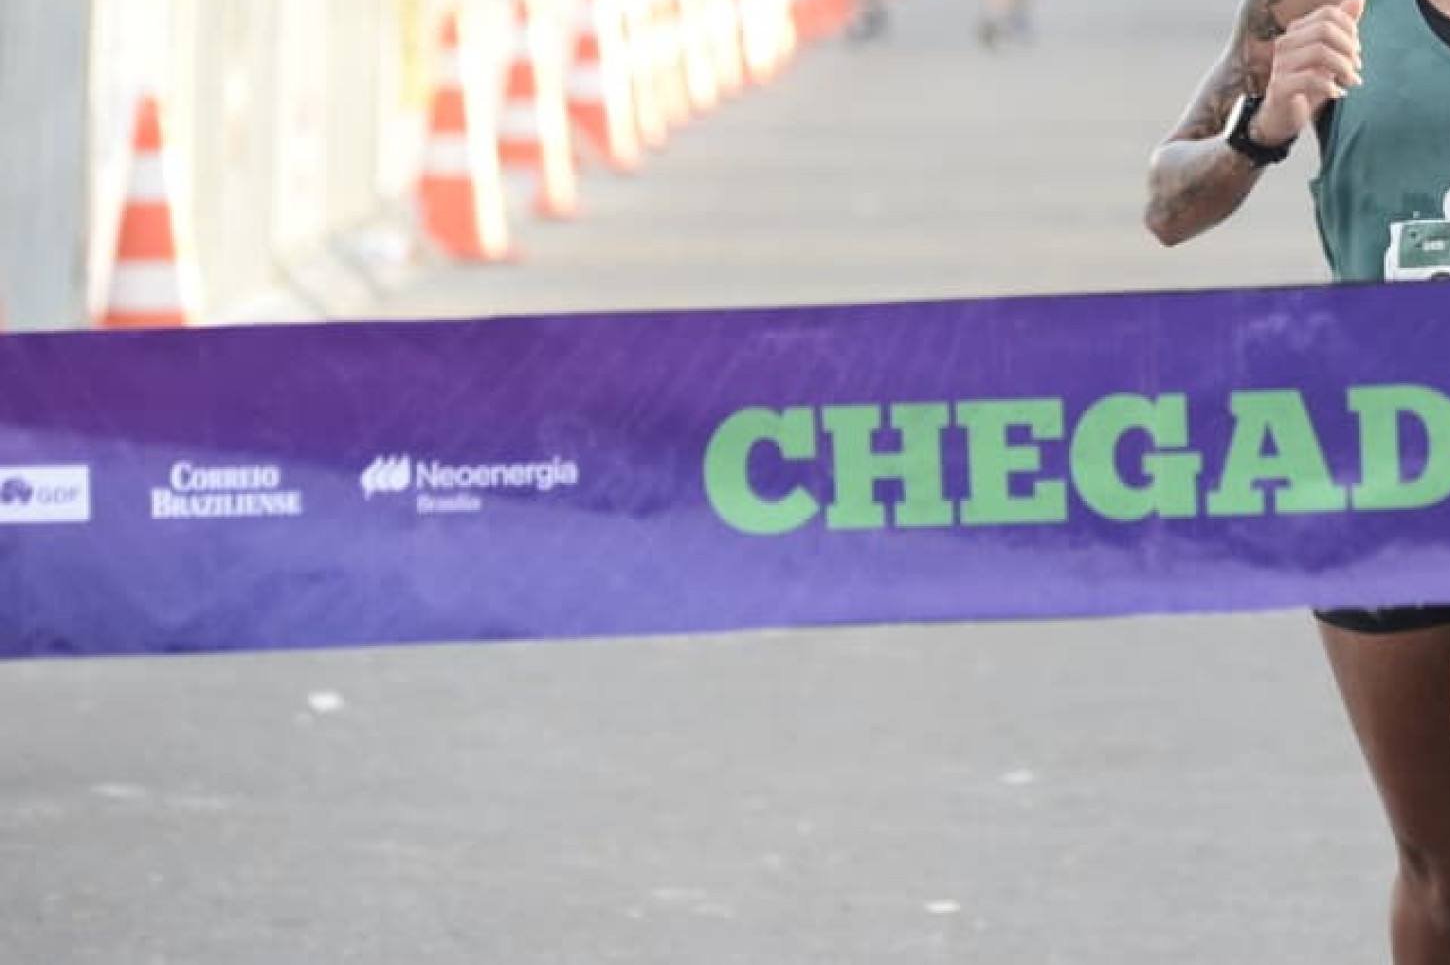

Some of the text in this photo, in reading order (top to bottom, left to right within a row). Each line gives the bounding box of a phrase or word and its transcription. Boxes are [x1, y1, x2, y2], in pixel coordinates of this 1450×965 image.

[171, 461, 280, 490] CORREIO
[416, 455, 578, 490] Neoenergia
[151, 488, 302, 518] BRAZILIENSE
